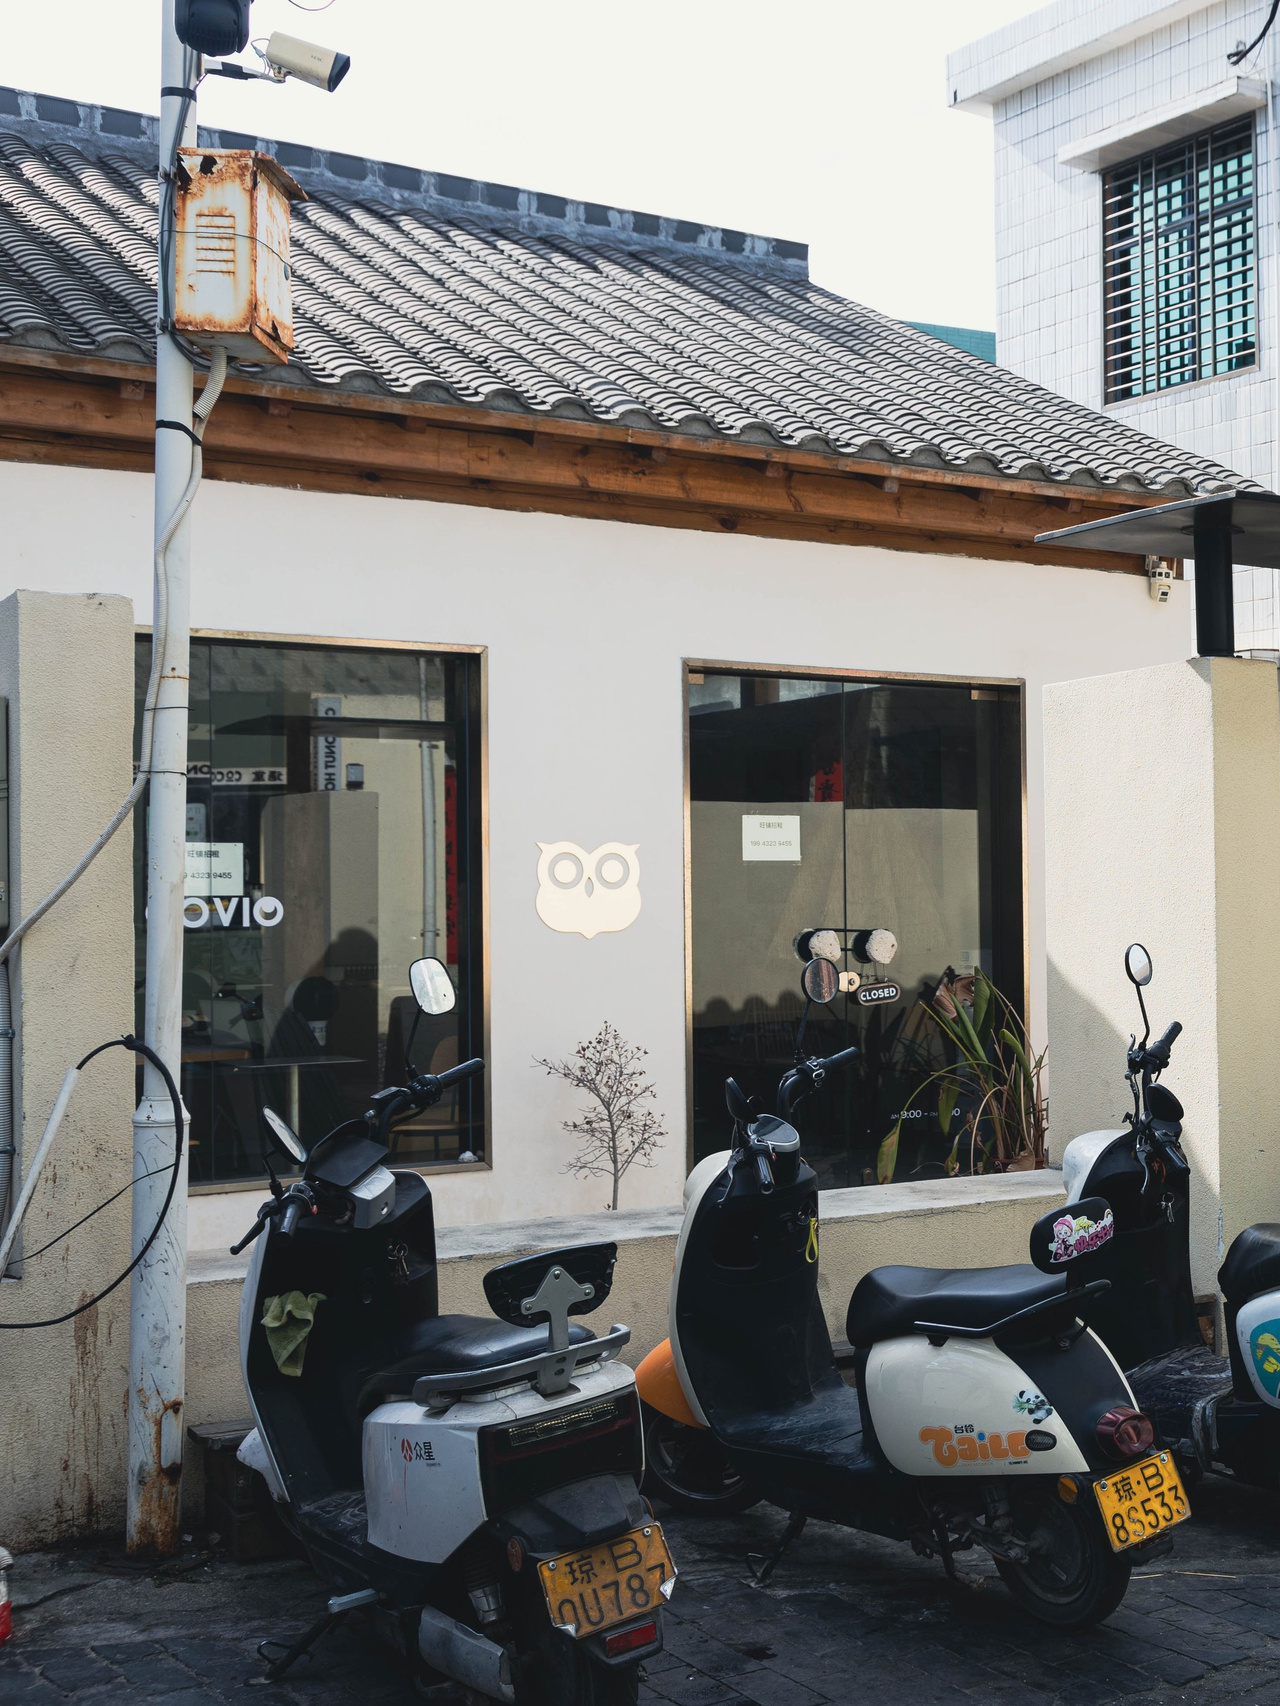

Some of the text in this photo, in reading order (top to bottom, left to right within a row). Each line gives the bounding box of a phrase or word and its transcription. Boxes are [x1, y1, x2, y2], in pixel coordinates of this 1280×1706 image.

[212, 871, 233, 880] 9455
[183, 896, 284, 928] OVIO
[860, 987, 897, 1001] CLOSED
[413, 1441, 436, 1461] 众星
[1111, 1484, 1186, 1544] 8S533
